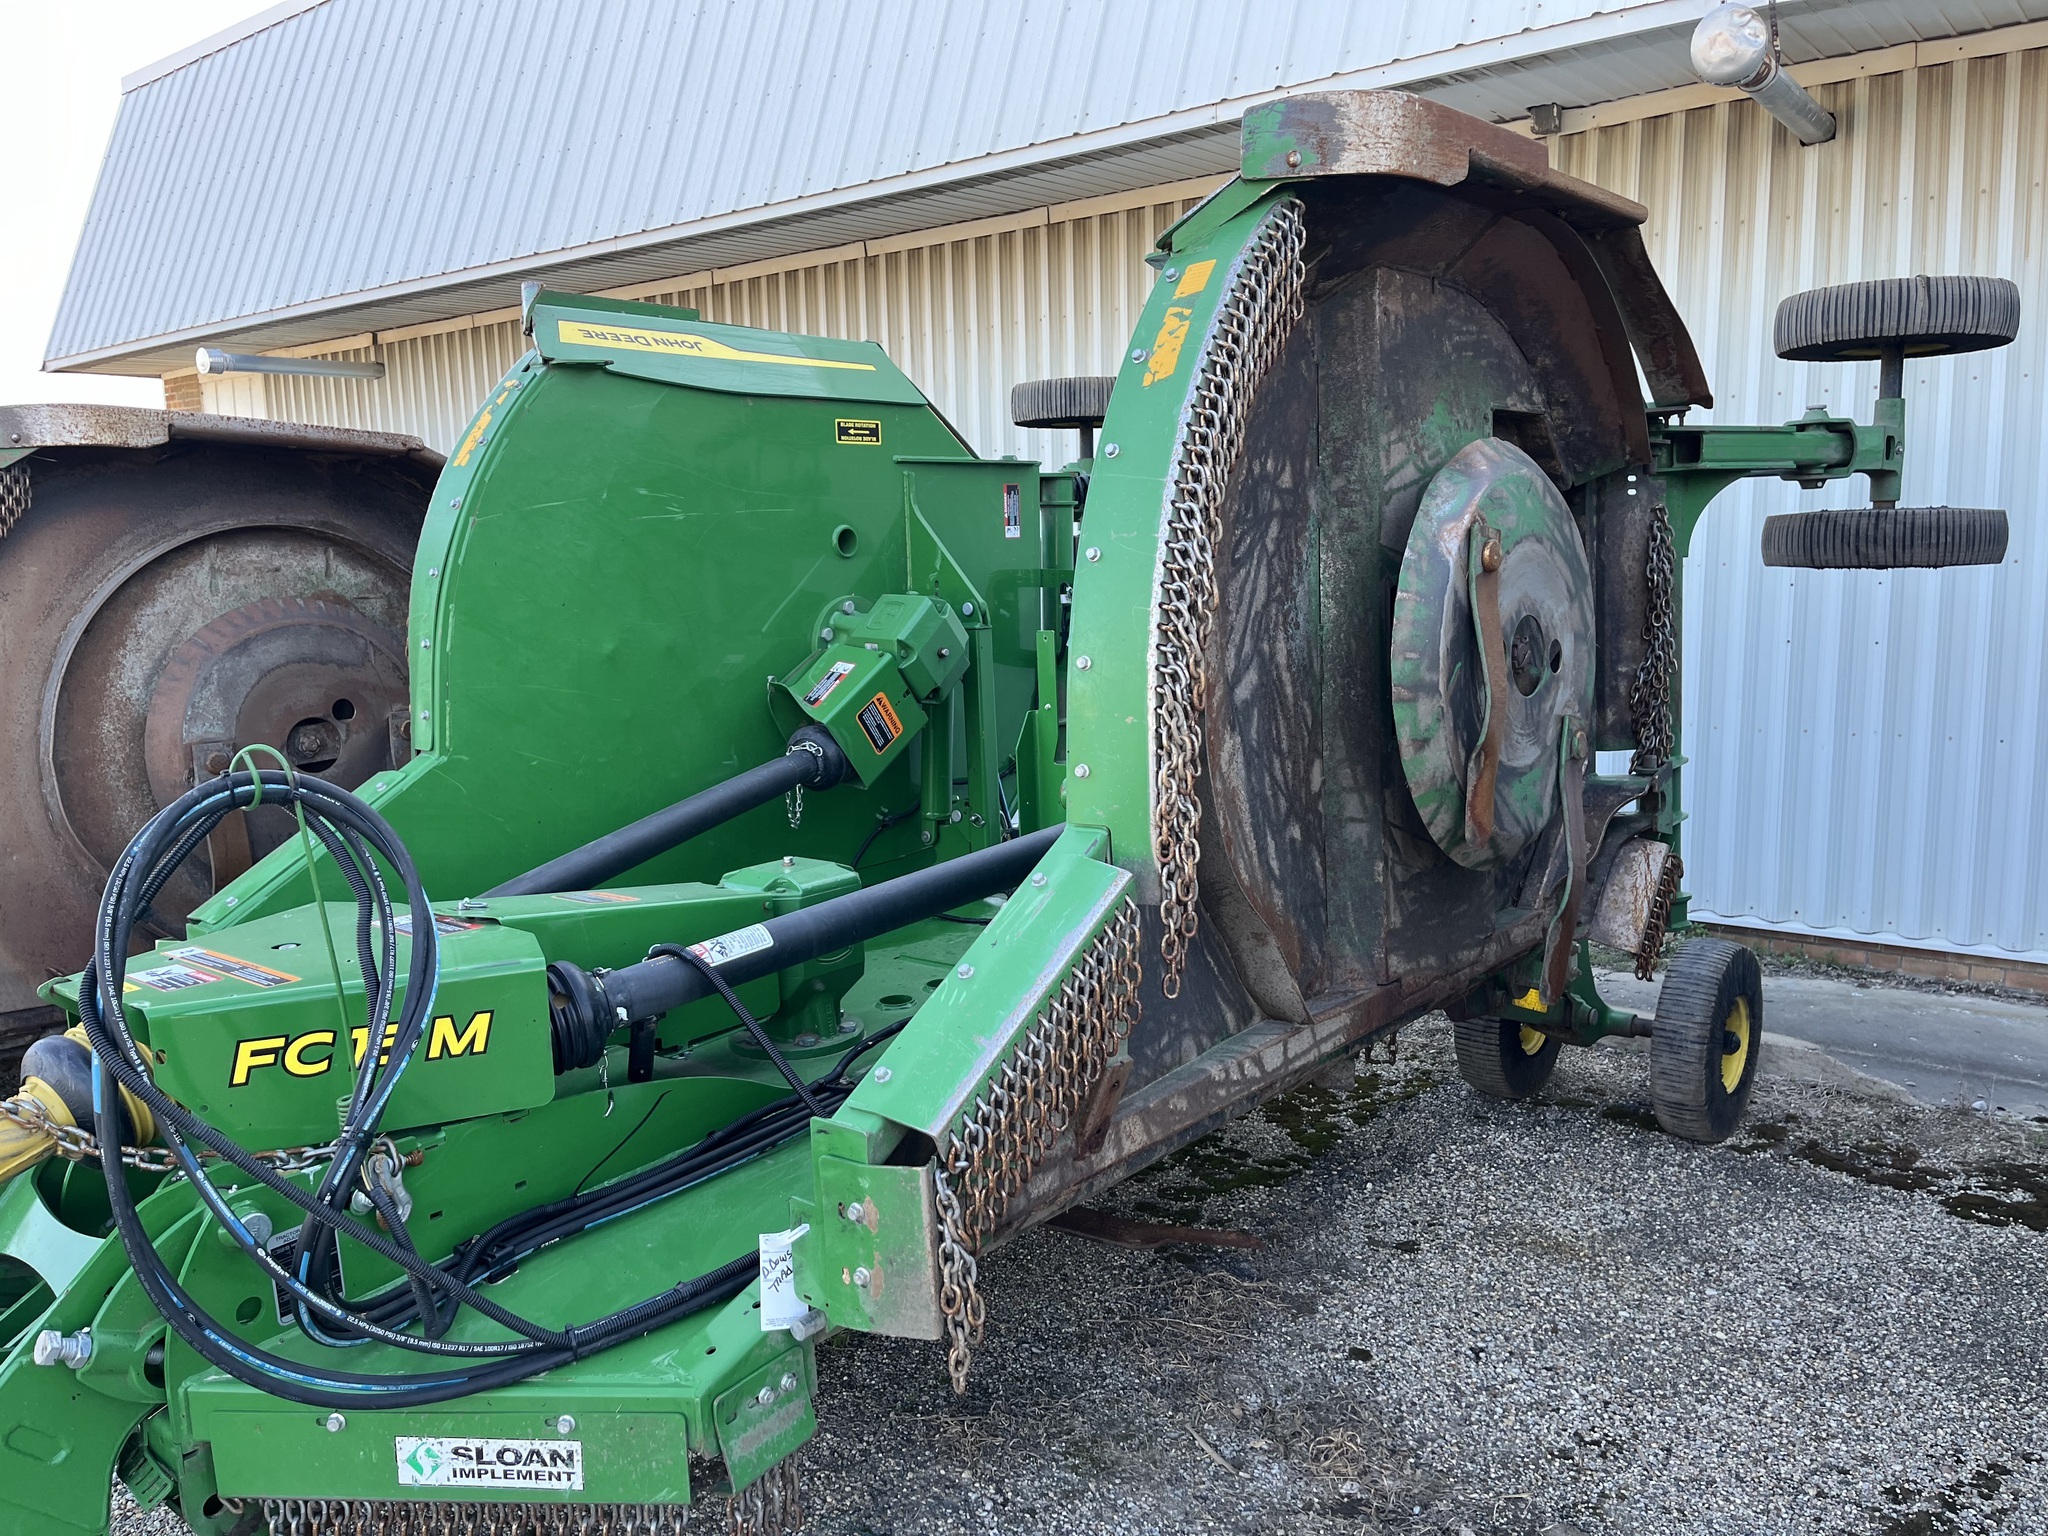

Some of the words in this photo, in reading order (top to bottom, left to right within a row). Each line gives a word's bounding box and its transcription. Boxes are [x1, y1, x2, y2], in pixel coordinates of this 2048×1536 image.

[577, 328, 652, 347] DEERE
[651, 337, 703, 352] JOHN
[881, 702, 901, 734] WARNING
[276, 1229, 301, 1241] TRACTOR
[346, 1314, 359, 1324] 22.5
[357, 1320, 369, 1329] MPa
[484, 1343, 504, 1352] 100R17
[451, 1446, 576, 1469] SLOAN
[452, 1468, 576, 1482] IMPLEMENT
